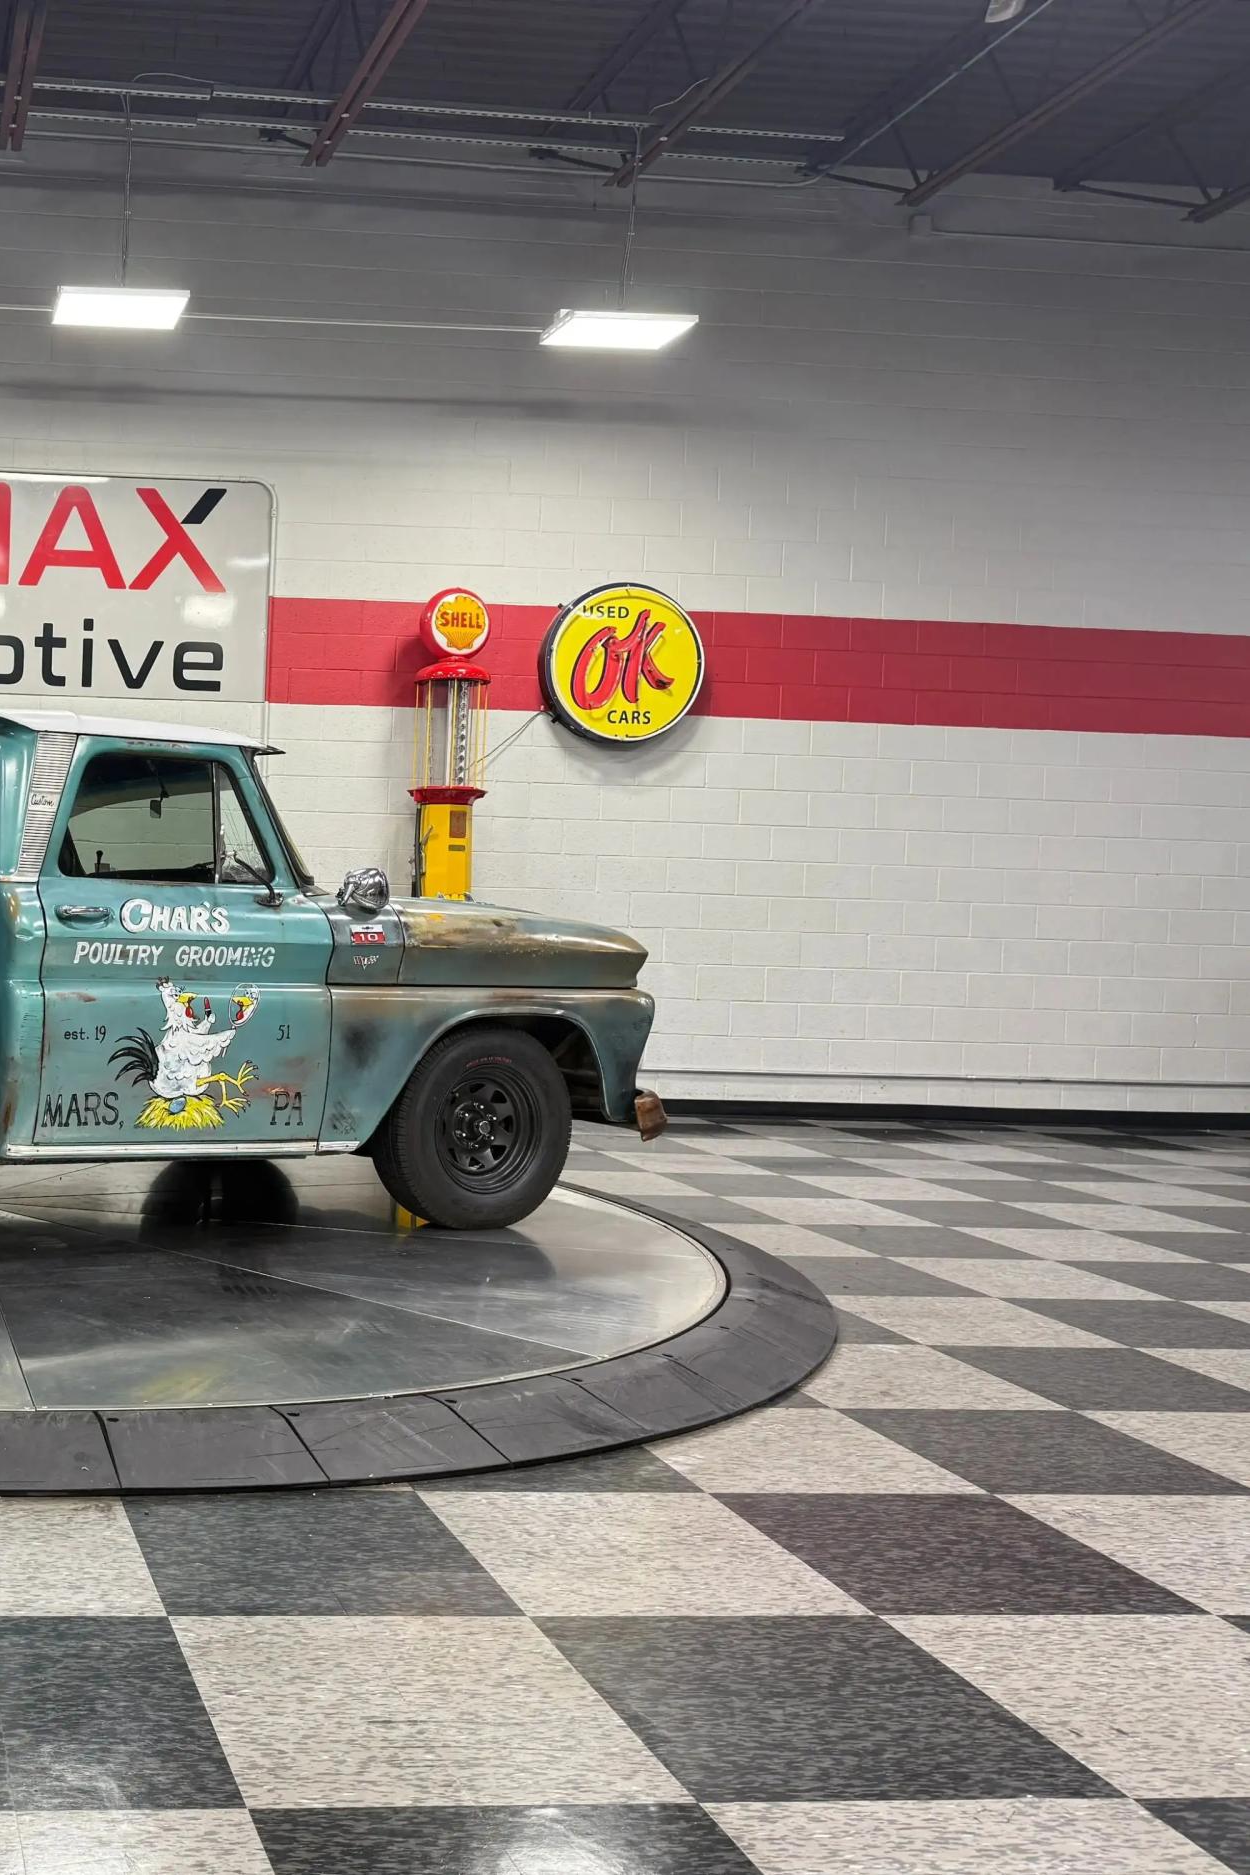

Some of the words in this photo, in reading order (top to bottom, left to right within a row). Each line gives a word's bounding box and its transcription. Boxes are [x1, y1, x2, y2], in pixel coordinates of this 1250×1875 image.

[439, 611, 483, 630] SHELL
[582, 605, 630, 619] USED
[570, 608, 675, 711] OK
[607, 710, 651, 724] CARS
[31, 794, 55, 807] Custom
[359, 933, 379, 942] 10
[73, 941, 165, 967] POULTRY
[175, 945, 276, 968] GROOMING
[64, 1027, 90, 1040] est.
[95, 1025, 107, 1043] 19
[276, 1024, 291, 1041] 51
[41, 1091, 124, 1130] MARS,
[270, 1091, 304, 1126] PA
